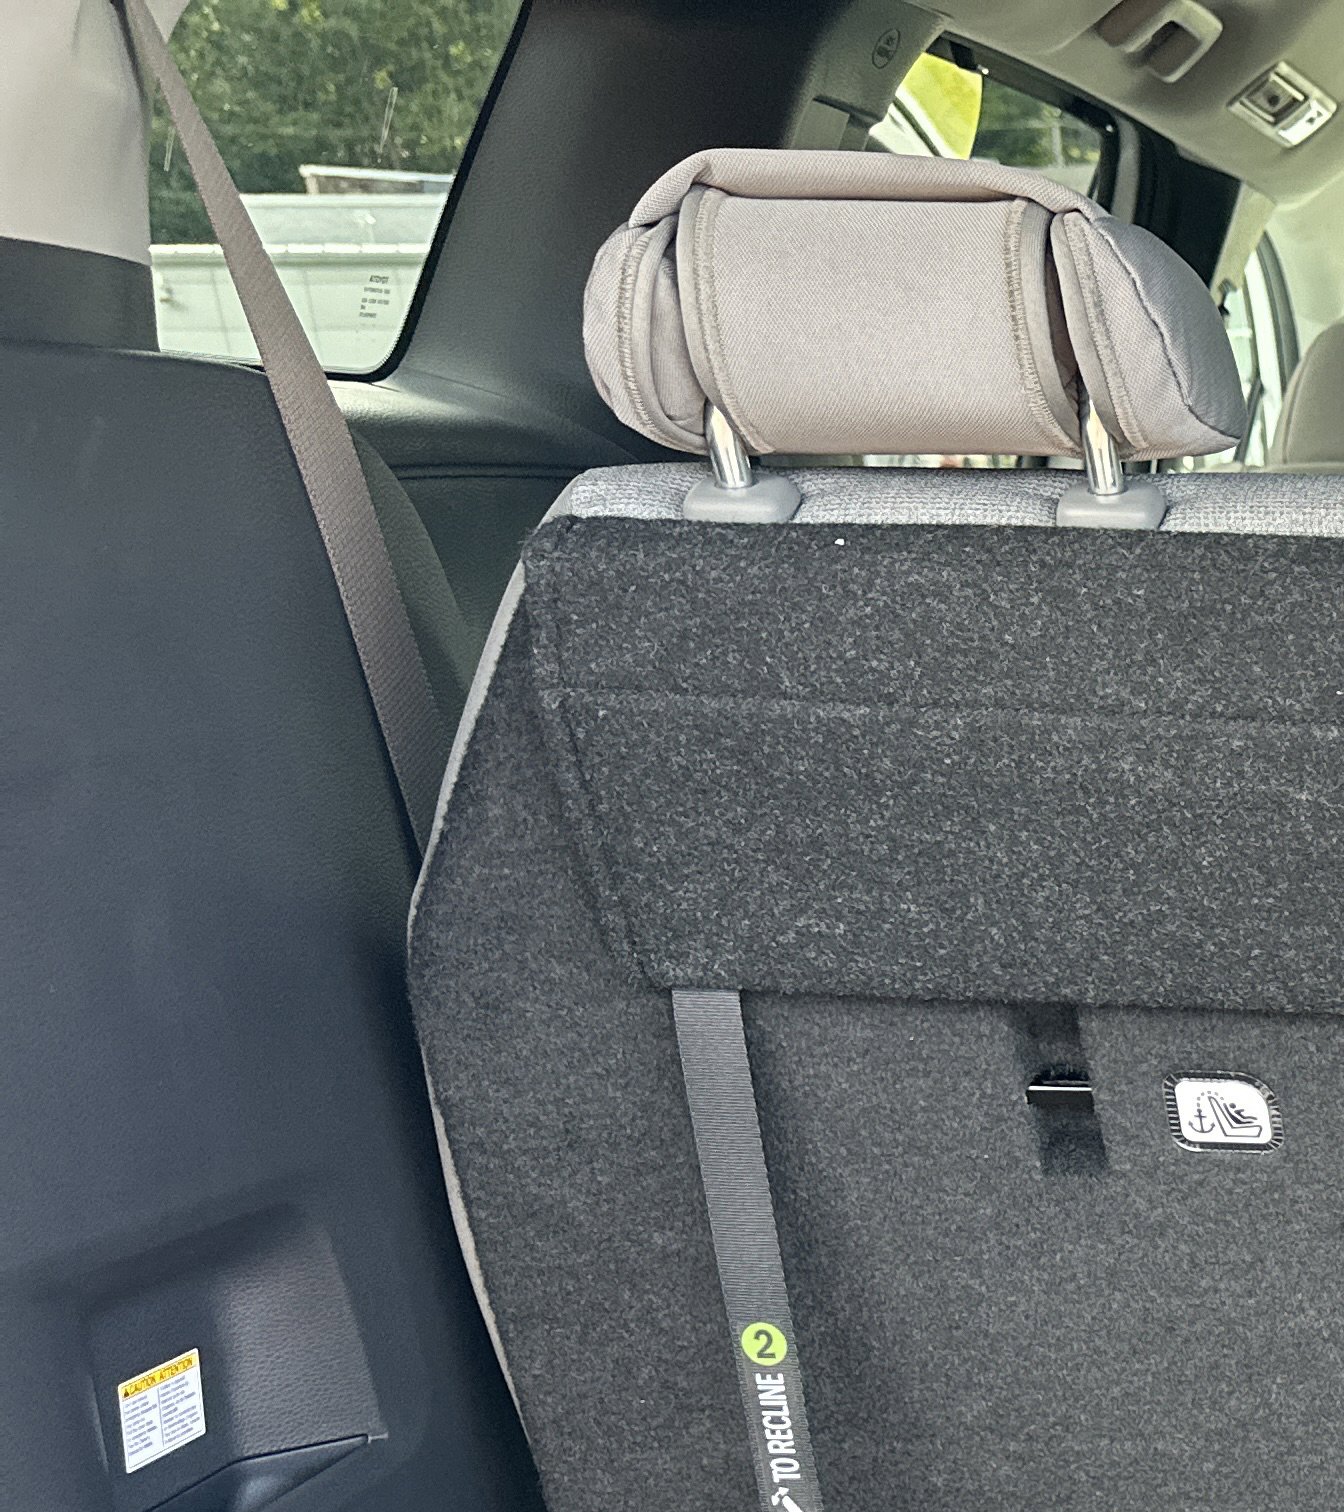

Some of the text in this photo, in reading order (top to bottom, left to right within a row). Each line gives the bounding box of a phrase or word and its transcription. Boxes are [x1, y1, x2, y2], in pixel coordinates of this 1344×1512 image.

[754, 1329, 777, 1359] 2
[755, 1372, 801, 1483] TO RECLINE
